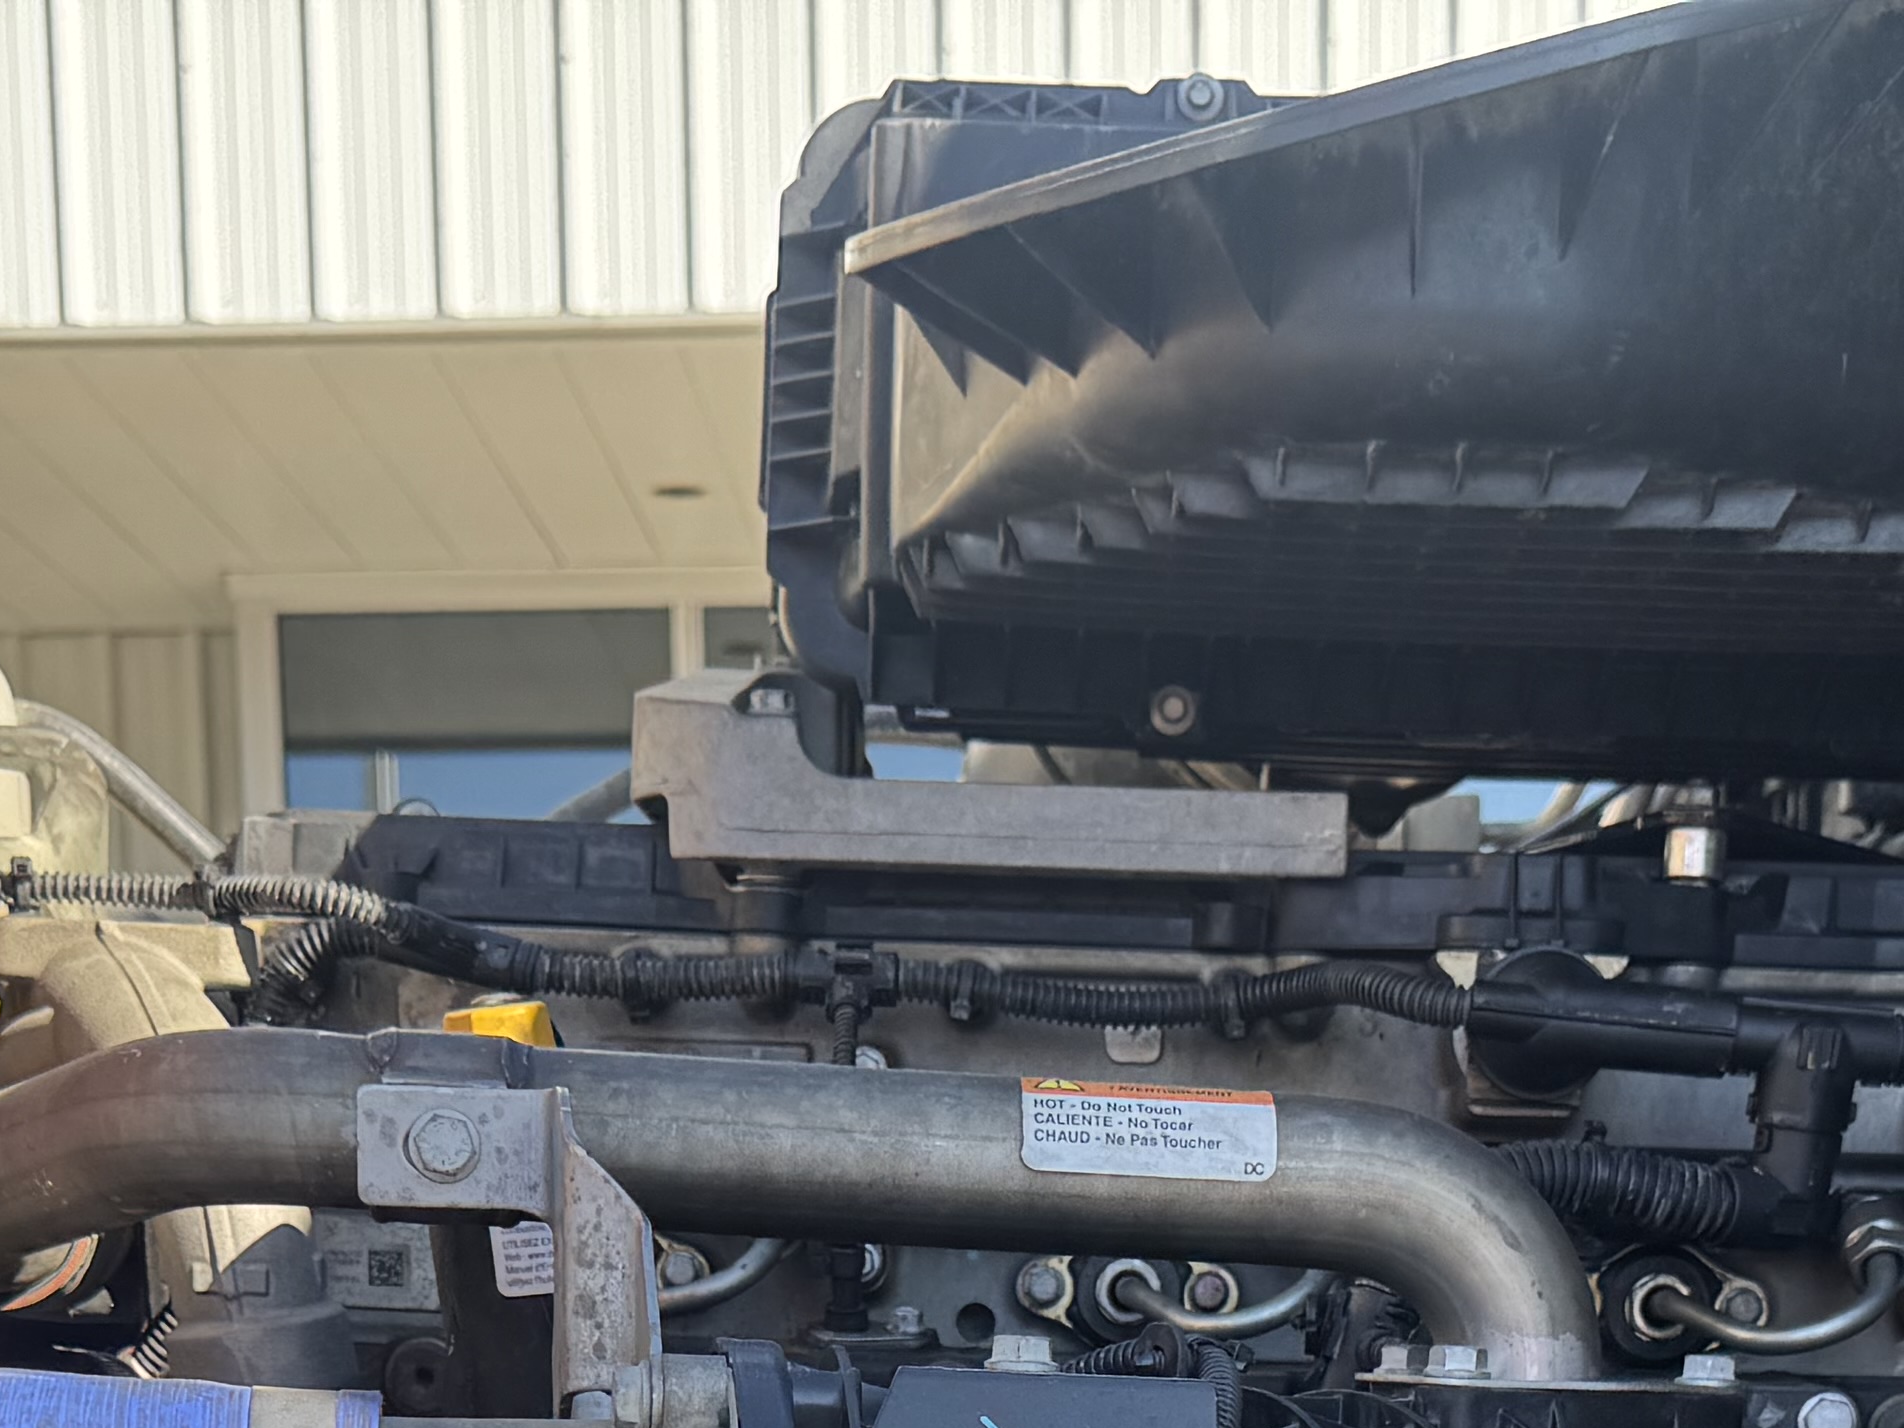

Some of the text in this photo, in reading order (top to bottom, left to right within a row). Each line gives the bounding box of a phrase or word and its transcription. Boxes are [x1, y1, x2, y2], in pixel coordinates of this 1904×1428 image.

[1033, 1098, 1182, 1116] HOT Do Not Touch
[1033, 1112, 1194, 1131] CALIENTE No Tocar
[1033, 1130, 1223, 1150] CHAUD Ne Pas Toucher
[1244, 1162, 1265, 1176] DC
